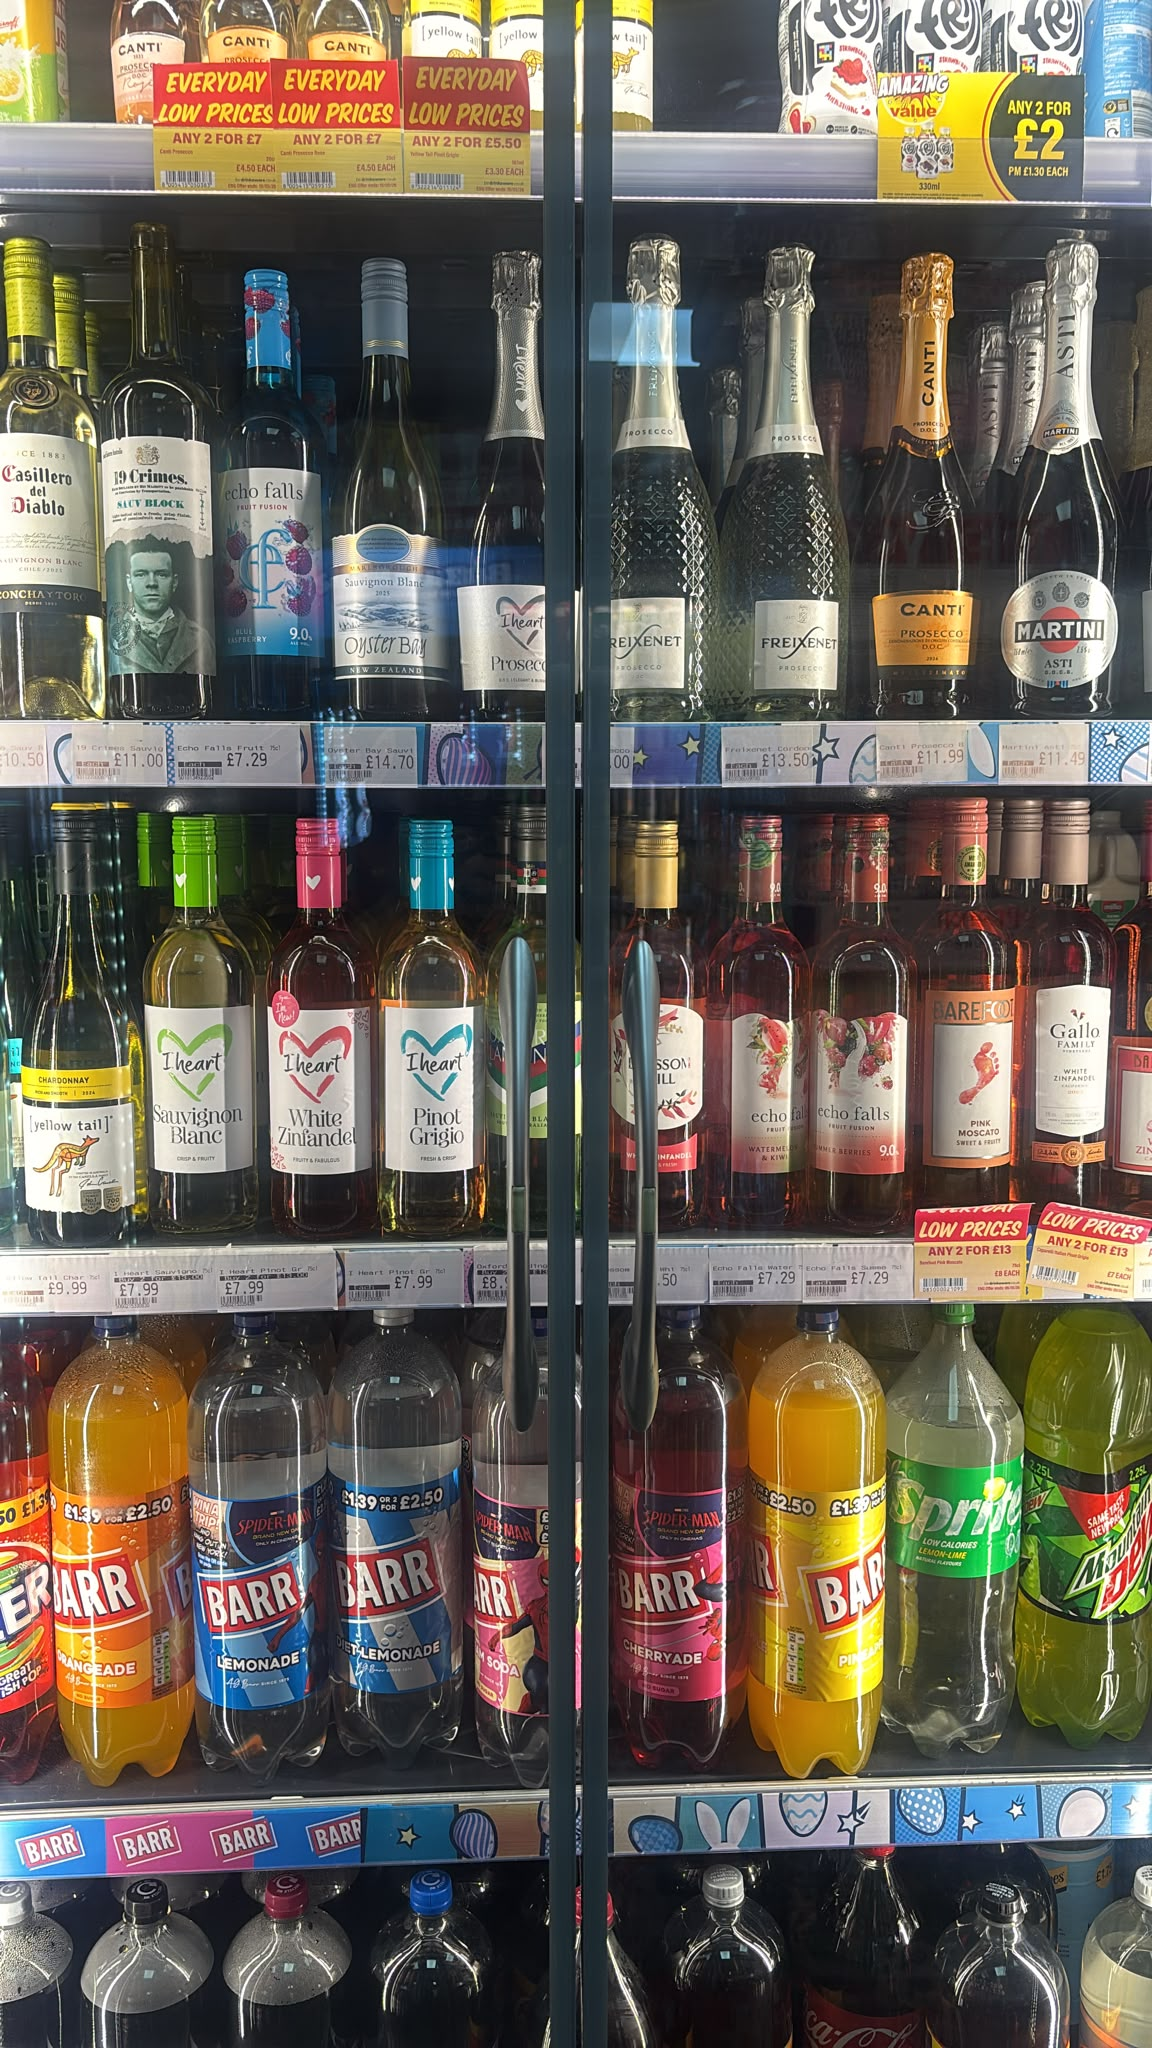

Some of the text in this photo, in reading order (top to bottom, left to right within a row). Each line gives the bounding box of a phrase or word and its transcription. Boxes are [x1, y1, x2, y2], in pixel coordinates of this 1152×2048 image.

[118, 42, 161, 56] CANTI
[223, 35, 270, 49] CANTI
[324, 40, 371, 55] CANTI
[166, 70, 268, 93] EVERYDAY
[284, 68, 386, 92] EVERYDAY
[416, 66, 517, 92] EVERYDAY
[878, 73, 949, 98] AMAZING
[158, 102, 273, 125] LOW PRICES
[278, 102, 394, 125] LOW PRICES
[408, 102, 525, 128] LOW PRICES
[890, 104, 937, 118] value
[1007, 100, 1071, 116] ANY 2 FOR
[173, 133, 262, 145] ANY 2 FOR £7
[293, 134, 382, 145] ANY 2 FOR £7
[412, 136, 522, 149] ANY 2 FOR £5.50
[1013, 118, 1065, 160] £2
[236, 164, 276, 173] £4.50 EACH
[356, 164, 396, 172] £4.50 EACH
[485, 167, 524, 176] £3.30 EACH
[1008, 166, 1069, 177] PM £1.30 EACH
[918, 182, 940, 191] 330ml
[1050, 314, 1075, 379] ASTI
[921, 340, 936, 406] CANTI
[624, 428, 673, 437] PROSECCO
[771, 435, 817, 443] PROSECCO
[1043, 427, 1079, 437] MARTINI
[2, 464, 72, 486] Casillero
[29, 486, 46, 497] del
[224, 481, 304, 501] echo falls
[11, 497, 65, 516] Diablo
[344, 577, 424, 589] Sauvignon Blanc
[900, 602, 962, 616] CANTI
[900, 629, 963, 638] PROSECCO
[1017, 621, 1102, 641] MARTINI
[344, 633, 428, 659] Oyster Bay
[761, 632, 837, 654] FREIXENET
[374, 667, 423, 675] ZEALAND
[1044, 658, 1073, 669] ASTI
[114, 753, 163, 767] £11.00
[226, 752, 267, 767] £7.29
[366, 755, 414, 770] £14.70
[762, 752, 809, 768] £13.50
[917, 749, 964, 764] £11.99
[1039, 751, 1086, 766] £11.49
[1050, 1020, 1100, 1039] Gallo
[1057, 1040, 1096, 1048] FAMILY
[38, 1076, 90, 1085] CHARDONNAY
[1053, 1074, 1096, 1082] ZINFANDEL
[153, 1103, 243, 1128] Sauvignon
[288, 1108, 342, 1128] White
[413, 1107, 461, 1126] Pinot
[818, 1105, 890, 1121] echo falls
[171, 1126, 223, 1145] Blanc
[278, 1126, 357, 1147] Zinfandel
[409, 1126, 464, 1148] Grigio
[958, 1128, 1000, 1137] MOSCATO
[919, 1220, 1022, 1239] LOW PRICES
[1041, 1211, 1144, 1241] LOW PRICES
[928, 1245, 1012, 1256] ANY 2 FOR £13
[1047, 1235, 1128, 1258] ANY 2 FOR £13
[394, 1275, 433, 1289] £7.99
[758, 1271, 796, 1285] £7.29
[851, 1271, 889, 1285] £7.29
[1004, 1269, 1020, 1277] EACH
[48, 1281, 87, 1295] £9.99
[119, 1283, 158, 1297] £7.99
[225, 1281, 264, 1295] £7.99
[126, 1495, 172, 1521] £2.50
[341, 1489, 377, 1510] £1.39
[400, 1488, 443, 1511] £2.50
[770, 1491, 816, 1516] £2.50
[830, 1496, 870, 1516] £1.39
[64, 1502, 102, 1523] £1.39
[888, 1478, 1022, 1541] Sprite
[1087, 1491, 1125, 1530] SAME TASTE
[235, 1507, 311, 1536] SPIDER-MAN
[645, 1510, 720, 1529] SPIDER-MAN
[923, 1537, 978, 1549] LOW CALORIES
[915, 1556, 936, 1564] NATURAL
[918, 1547, 968, 1560] LEMON-LIME
[335, 1549, 434, 1609] BARR
[207, 1571, 298, 1627] BARR
[618, 1570, 700, 1614] BARR
[361, 1641, 441, 1663] LEMONADE
[623, 1638, 702, 1665] CHERRYADE
[56, 1649, 137, 1677] ORANGEADE
[216, 1651, 300, 1672] LEMONADE
[487, 1657, 520, 1678] SODA
[120, 1828, 174, 1860] BARR
[219, 1824, 271, 1856] BARR
[316, 1819, 361, 1853] BARR
[25, 1830, 78, 1863] BARR
